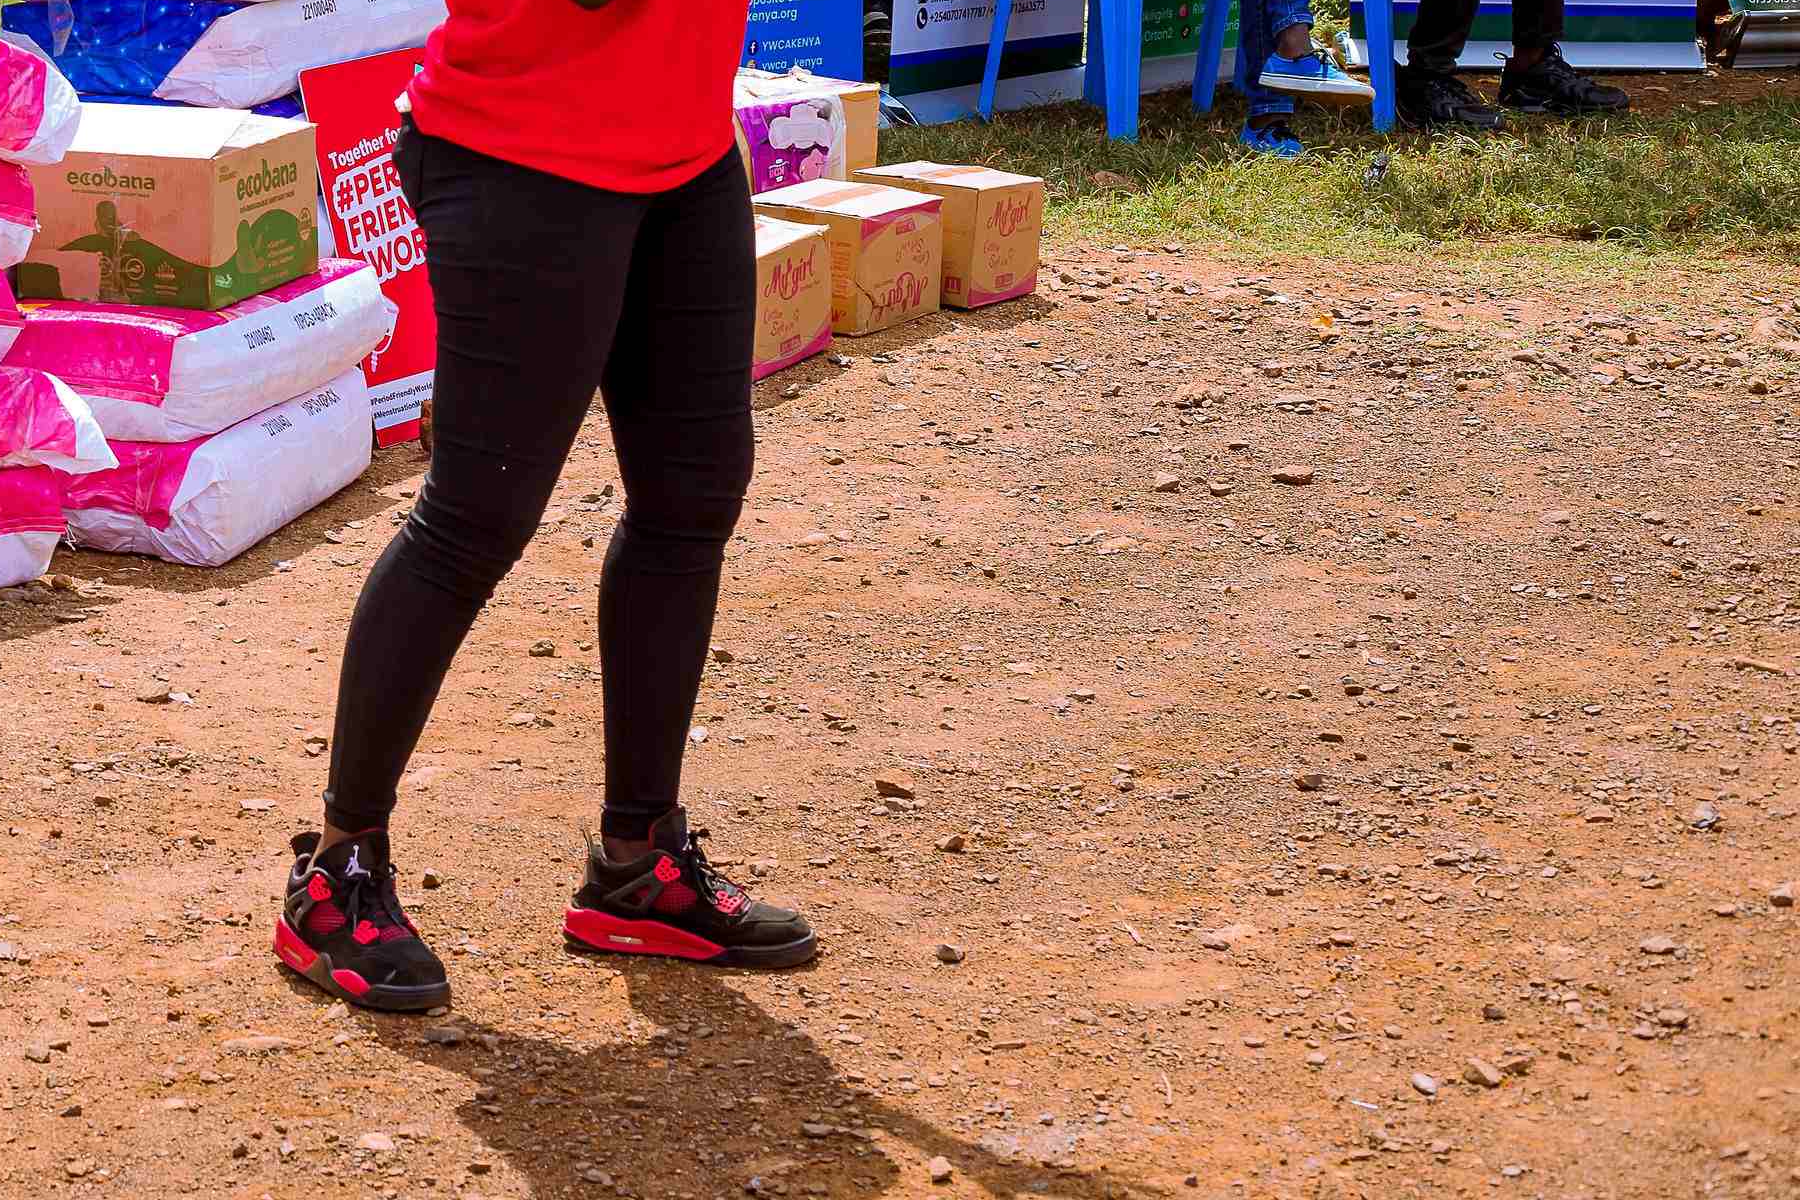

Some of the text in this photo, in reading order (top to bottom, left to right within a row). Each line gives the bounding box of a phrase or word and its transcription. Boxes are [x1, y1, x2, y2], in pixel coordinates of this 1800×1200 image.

[328, 133, 384, 170] Together
[66, 166, 156, 192] ecobana
[236, 158, 297, 201] ecobana
